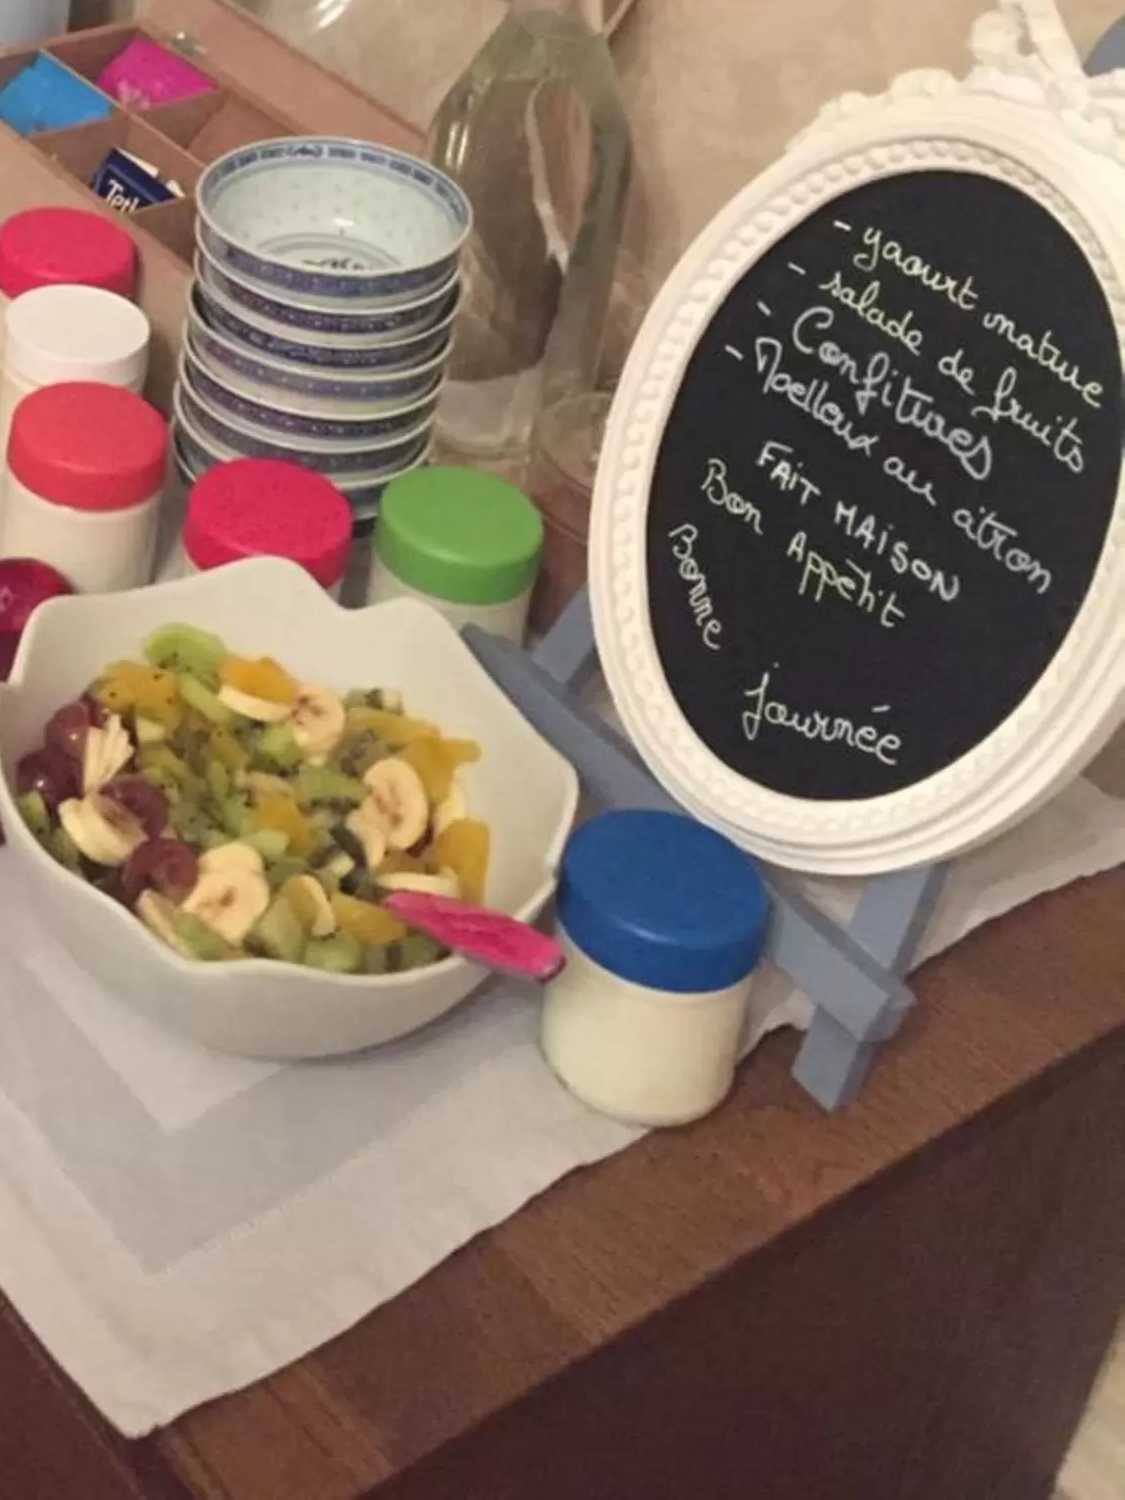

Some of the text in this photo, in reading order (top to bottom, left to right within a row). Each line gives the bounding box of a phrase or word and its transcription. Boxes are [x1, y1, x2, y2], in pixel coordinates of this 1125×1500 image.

[852, 226, 979, 310] yaourt
[818, 271, 924, 356] salade
[937, 348, 975, 396] de
[971, 366, 1084, 474] fruits
[700, 457, 764, 536] Bon
[883, 455, 938, 506] au
[952, 505, 1053, 595] citron
[667, 522, 723, 650] Bonne
